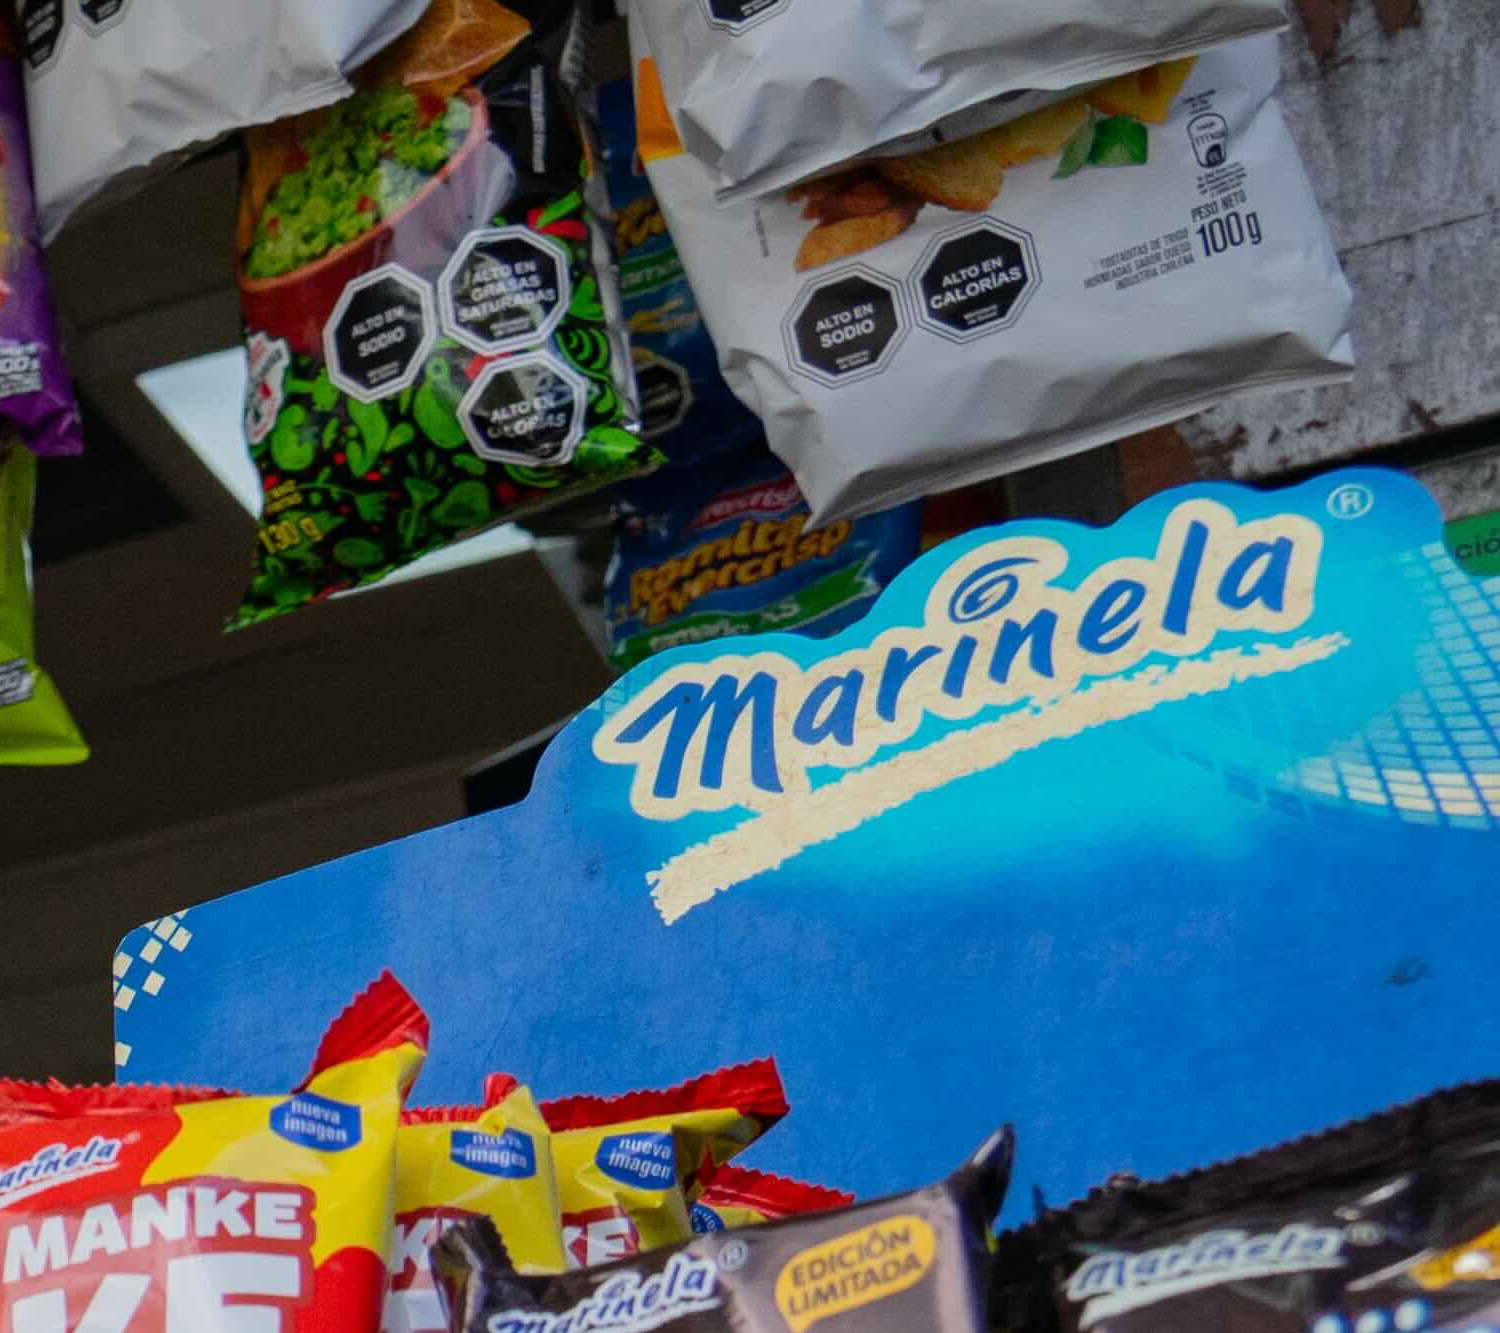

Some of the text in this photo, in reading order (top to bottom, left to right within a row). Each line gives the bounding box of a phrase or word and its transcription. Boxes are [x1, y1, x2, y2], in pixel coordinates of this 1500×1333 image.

[1190, 189, 1247, 223] PESO NETO
[513, 259, 538, 278] EN
[941, 255, 1004, 290] ALTO EN
[350, 303, 405, 339] ALTO EN
[815, 302, 875, 337] ALTO EN
[819, 318, 877, 350] SODIO
[357, 325, 407, 359] SODIO
[614, 518, 1294, 798] Marinela
[283, 1110, 348, 1146] imagen
[2, 1190, 303, 1285] MANKE
[790, 1226, 913, 1284] EDICIÓN
[787, 1256, 921, 1313] LIMITADA
